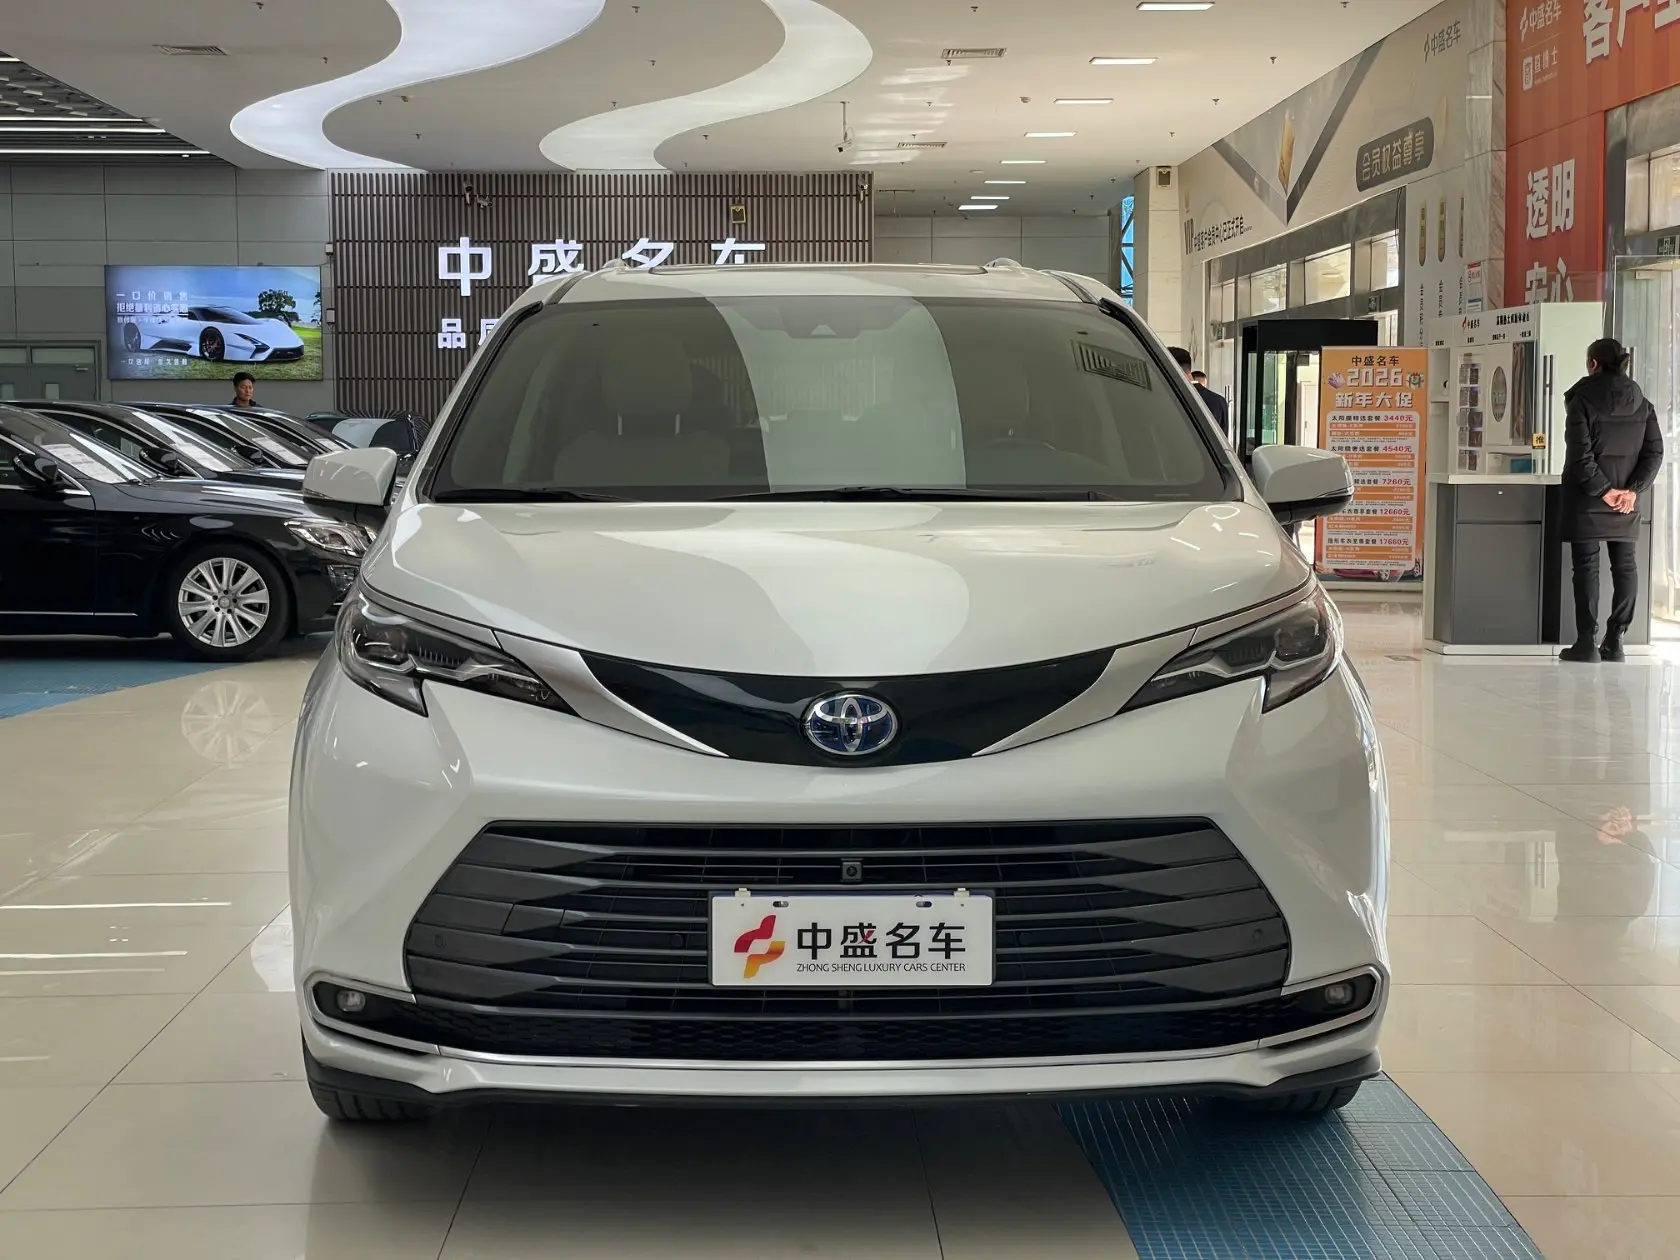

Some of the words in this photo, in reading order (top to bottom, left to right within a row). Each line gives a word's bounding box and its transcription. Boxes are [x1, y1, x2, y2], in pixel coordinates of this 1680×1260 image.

[1528, 0, 1563, 33] 中盛名车
[1430, 19, 1462, 56] 中盛名车
[1362, 127, 1425, 182] 会员权益尊享
[1526, 157, 1576, 241] 透明
[1351, 355, 1400, 366] 中盛名车
[1346, 367, 1403, 388] 2026
[1335, 391, 1413, 408] 新年大促
[1383, 414, 1414, 422] 3440元
[1382, 445, 1413, 453] 4540元
[1382, 478, 1412, 486] 7260元
[1379, 508, 1411, 516] 12660元
[1379, 538, 1409, 546] 17660元
[797, 922, 966, 959] 中盛名车
[797, 962, 830, 973] ZHONG
[831, 962, 863, 973] SHENG
[863, 962, 901, 973] LUXURY
[903, 962, 928, 973] CARS
[930, 962, 966, 973] CENTER
